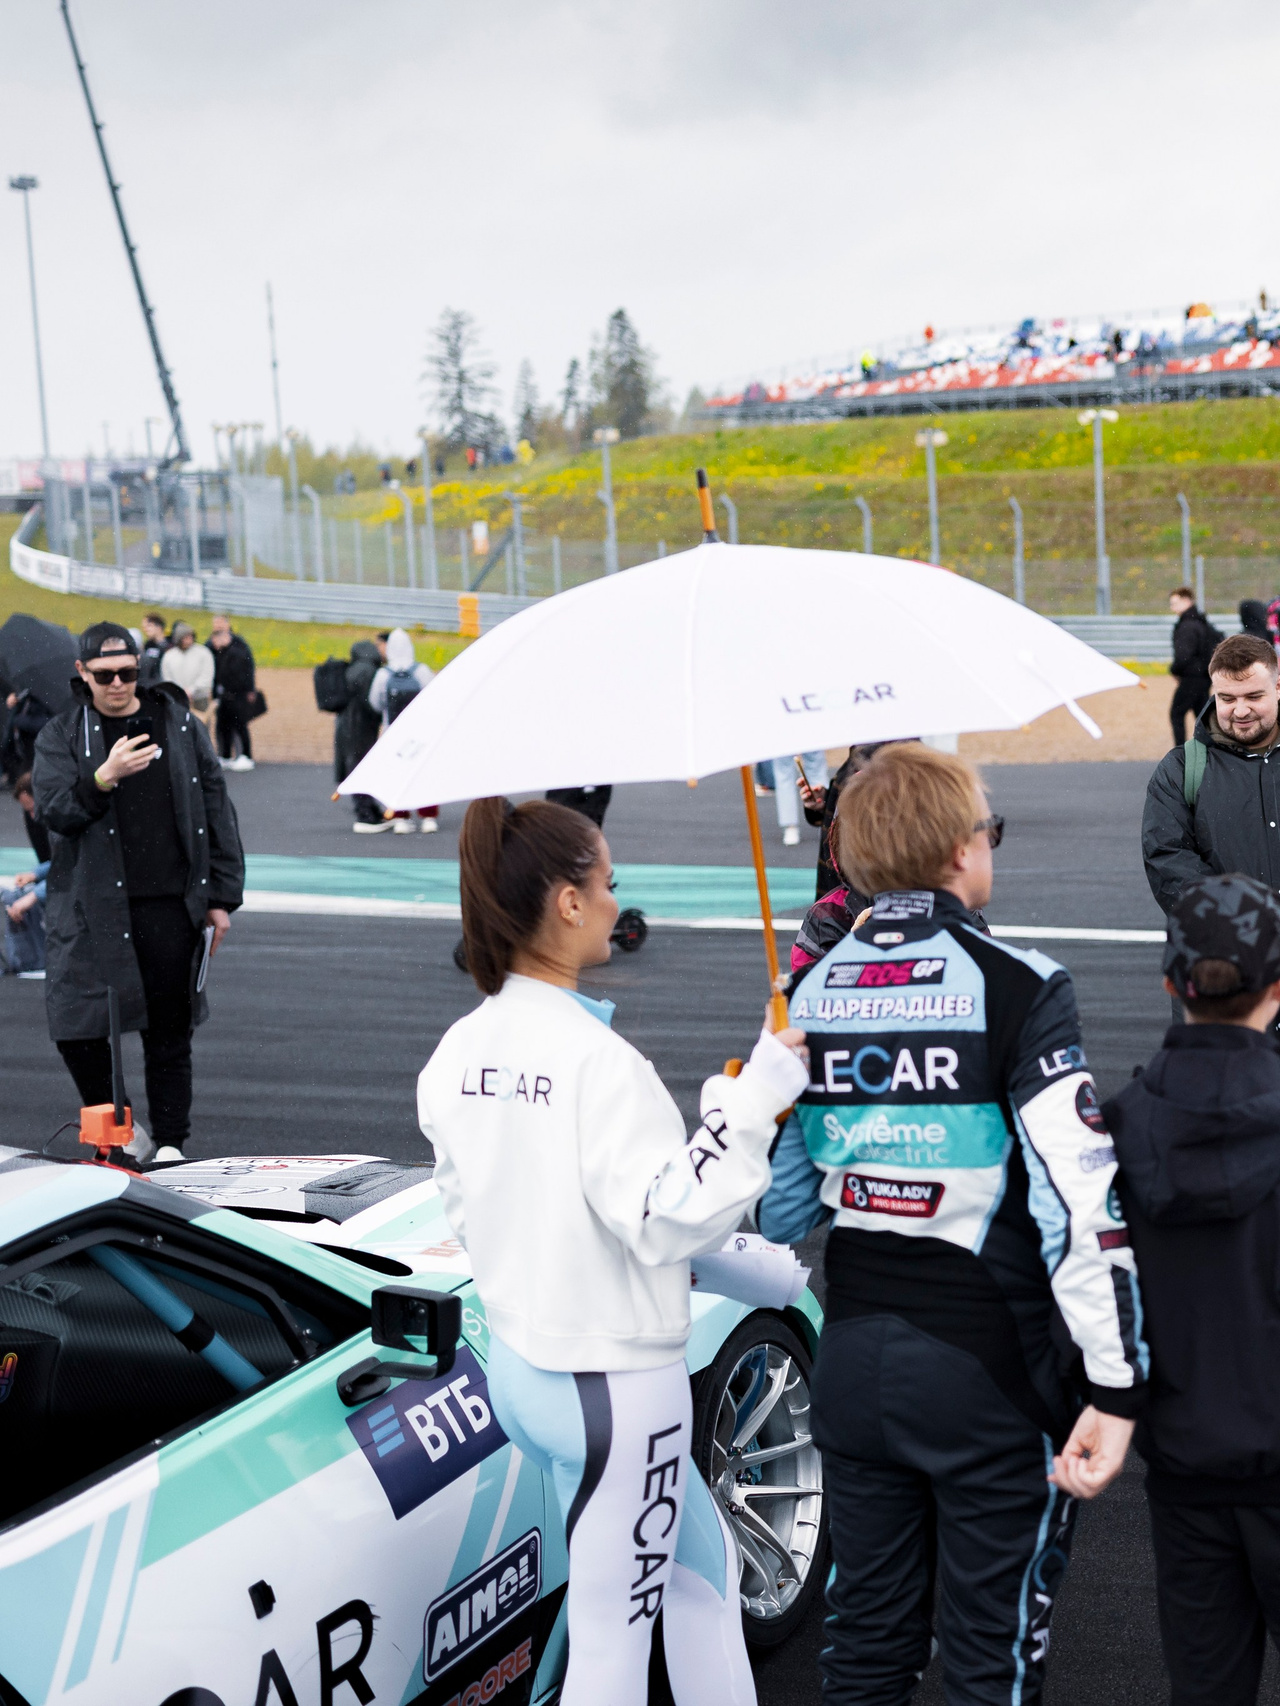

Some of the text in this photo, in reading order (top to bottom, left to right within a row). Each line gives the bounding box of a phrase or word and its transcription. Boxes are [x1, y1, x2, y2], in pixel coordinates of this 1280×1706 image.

[856, 959, 945, 987] RDS GP
[795, 994, 974, 1023] А. ЦАРЕГРАДЦЕВ
[865, 1181, 933, 1200] YUKA ADV
[404, 1374, 491, 1463] ВТБ
[628, 1422, 682, 1626] LECAR
[430, 1553, 535, 1666] AIMOL
